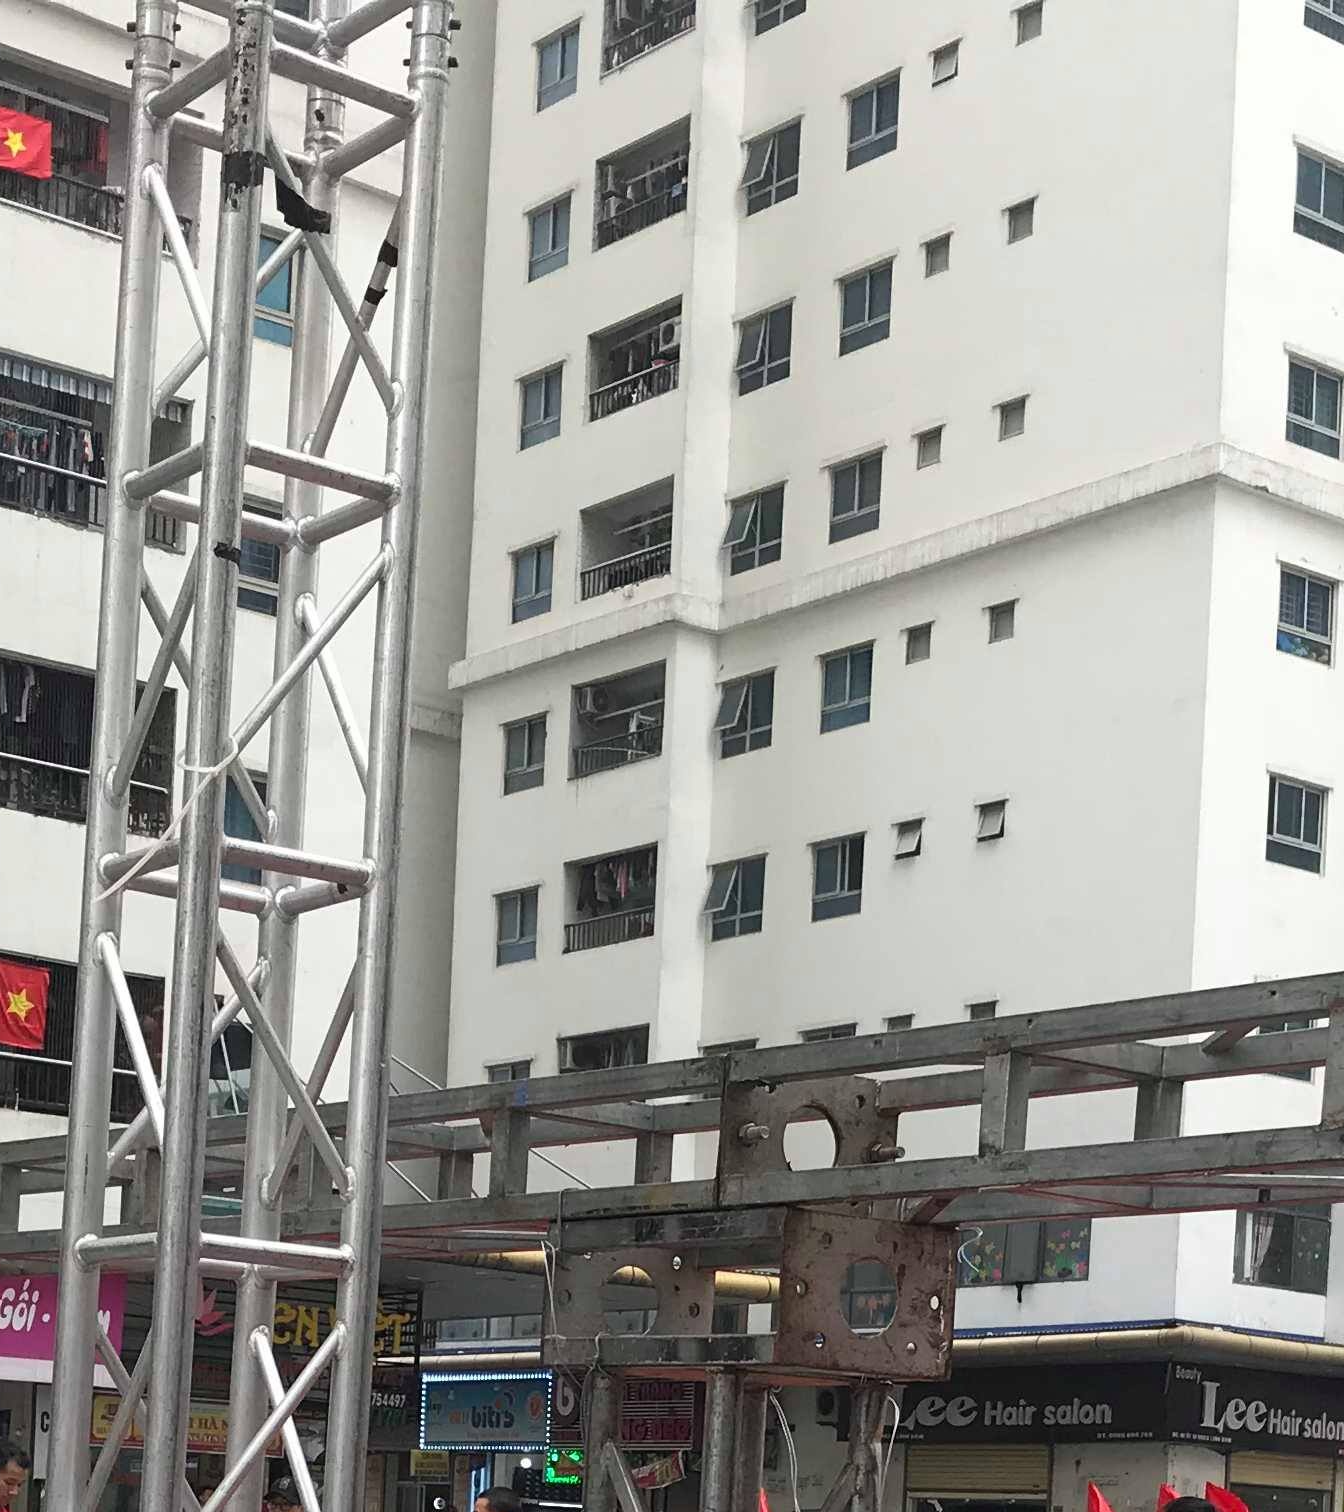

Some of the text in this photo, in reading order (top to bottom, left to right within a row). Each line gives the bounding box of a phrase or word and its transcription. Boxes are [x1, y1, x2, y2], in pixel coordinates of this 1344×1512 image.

[984, 1399, 1036, 1426] Hair
[1043, 1398, 1112, 1426] salon
[1200, 1380, 1268, 1433] Lee
[1267, 1407, 1303, 1435] Hair
